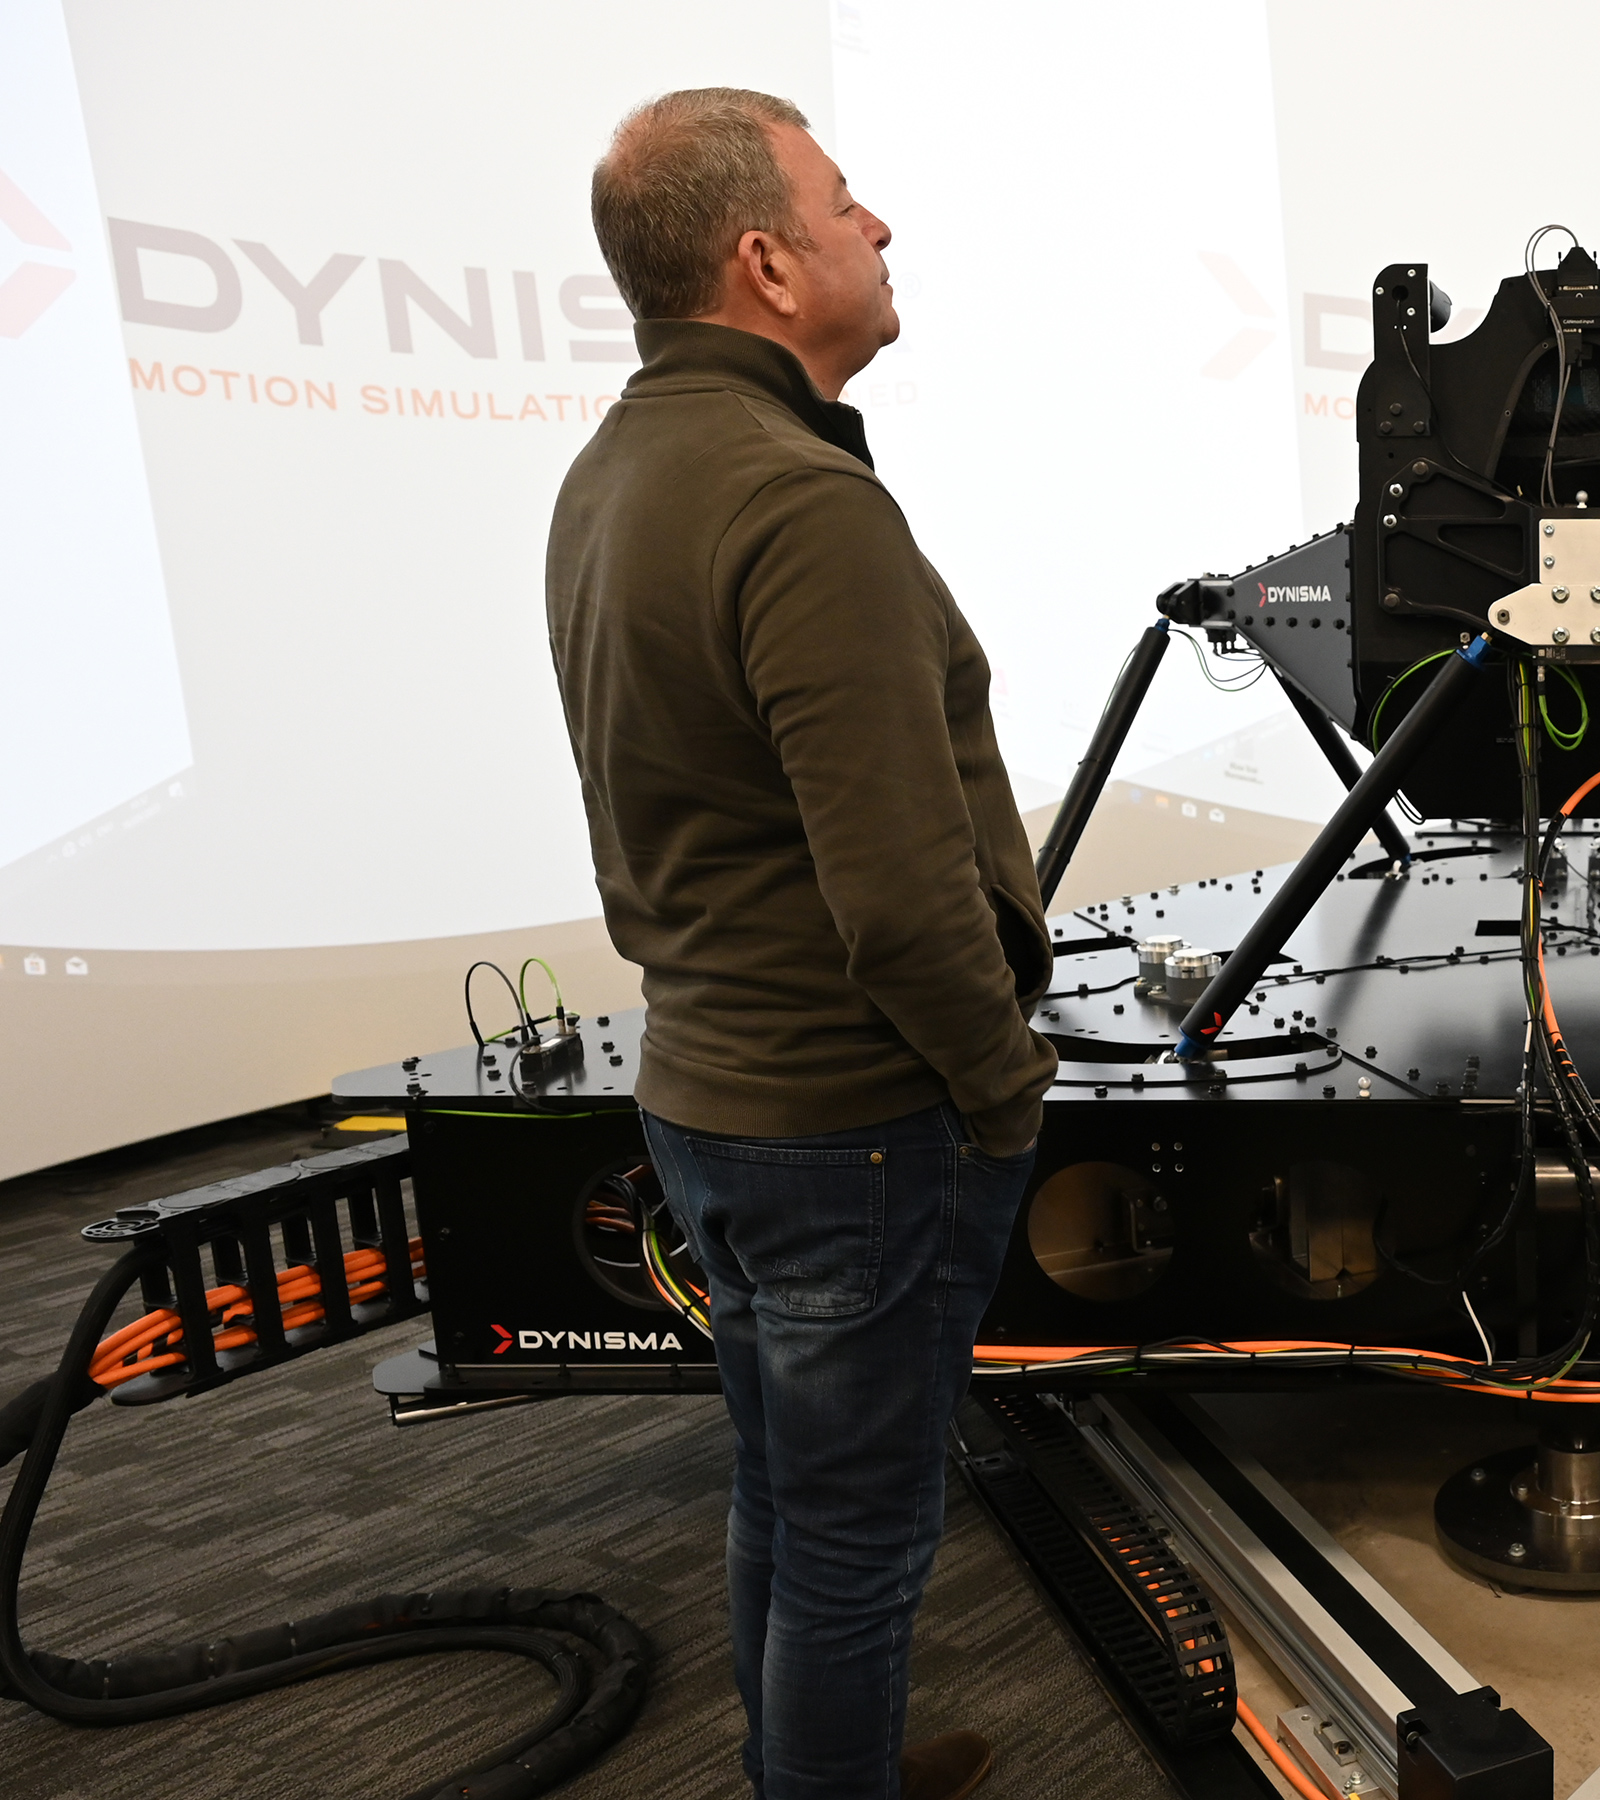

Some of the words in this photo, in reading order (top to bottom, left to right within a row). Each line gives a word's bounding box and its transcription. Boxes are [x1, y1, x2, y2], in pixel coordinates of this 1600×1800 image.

[107, 216, 641, 363] DYNIS
[128, 357, 338, 411] MOTION
[1267, 585, 1332, 603] DYNISMA
[518, 1330, 683, 1351] DYNISMA
